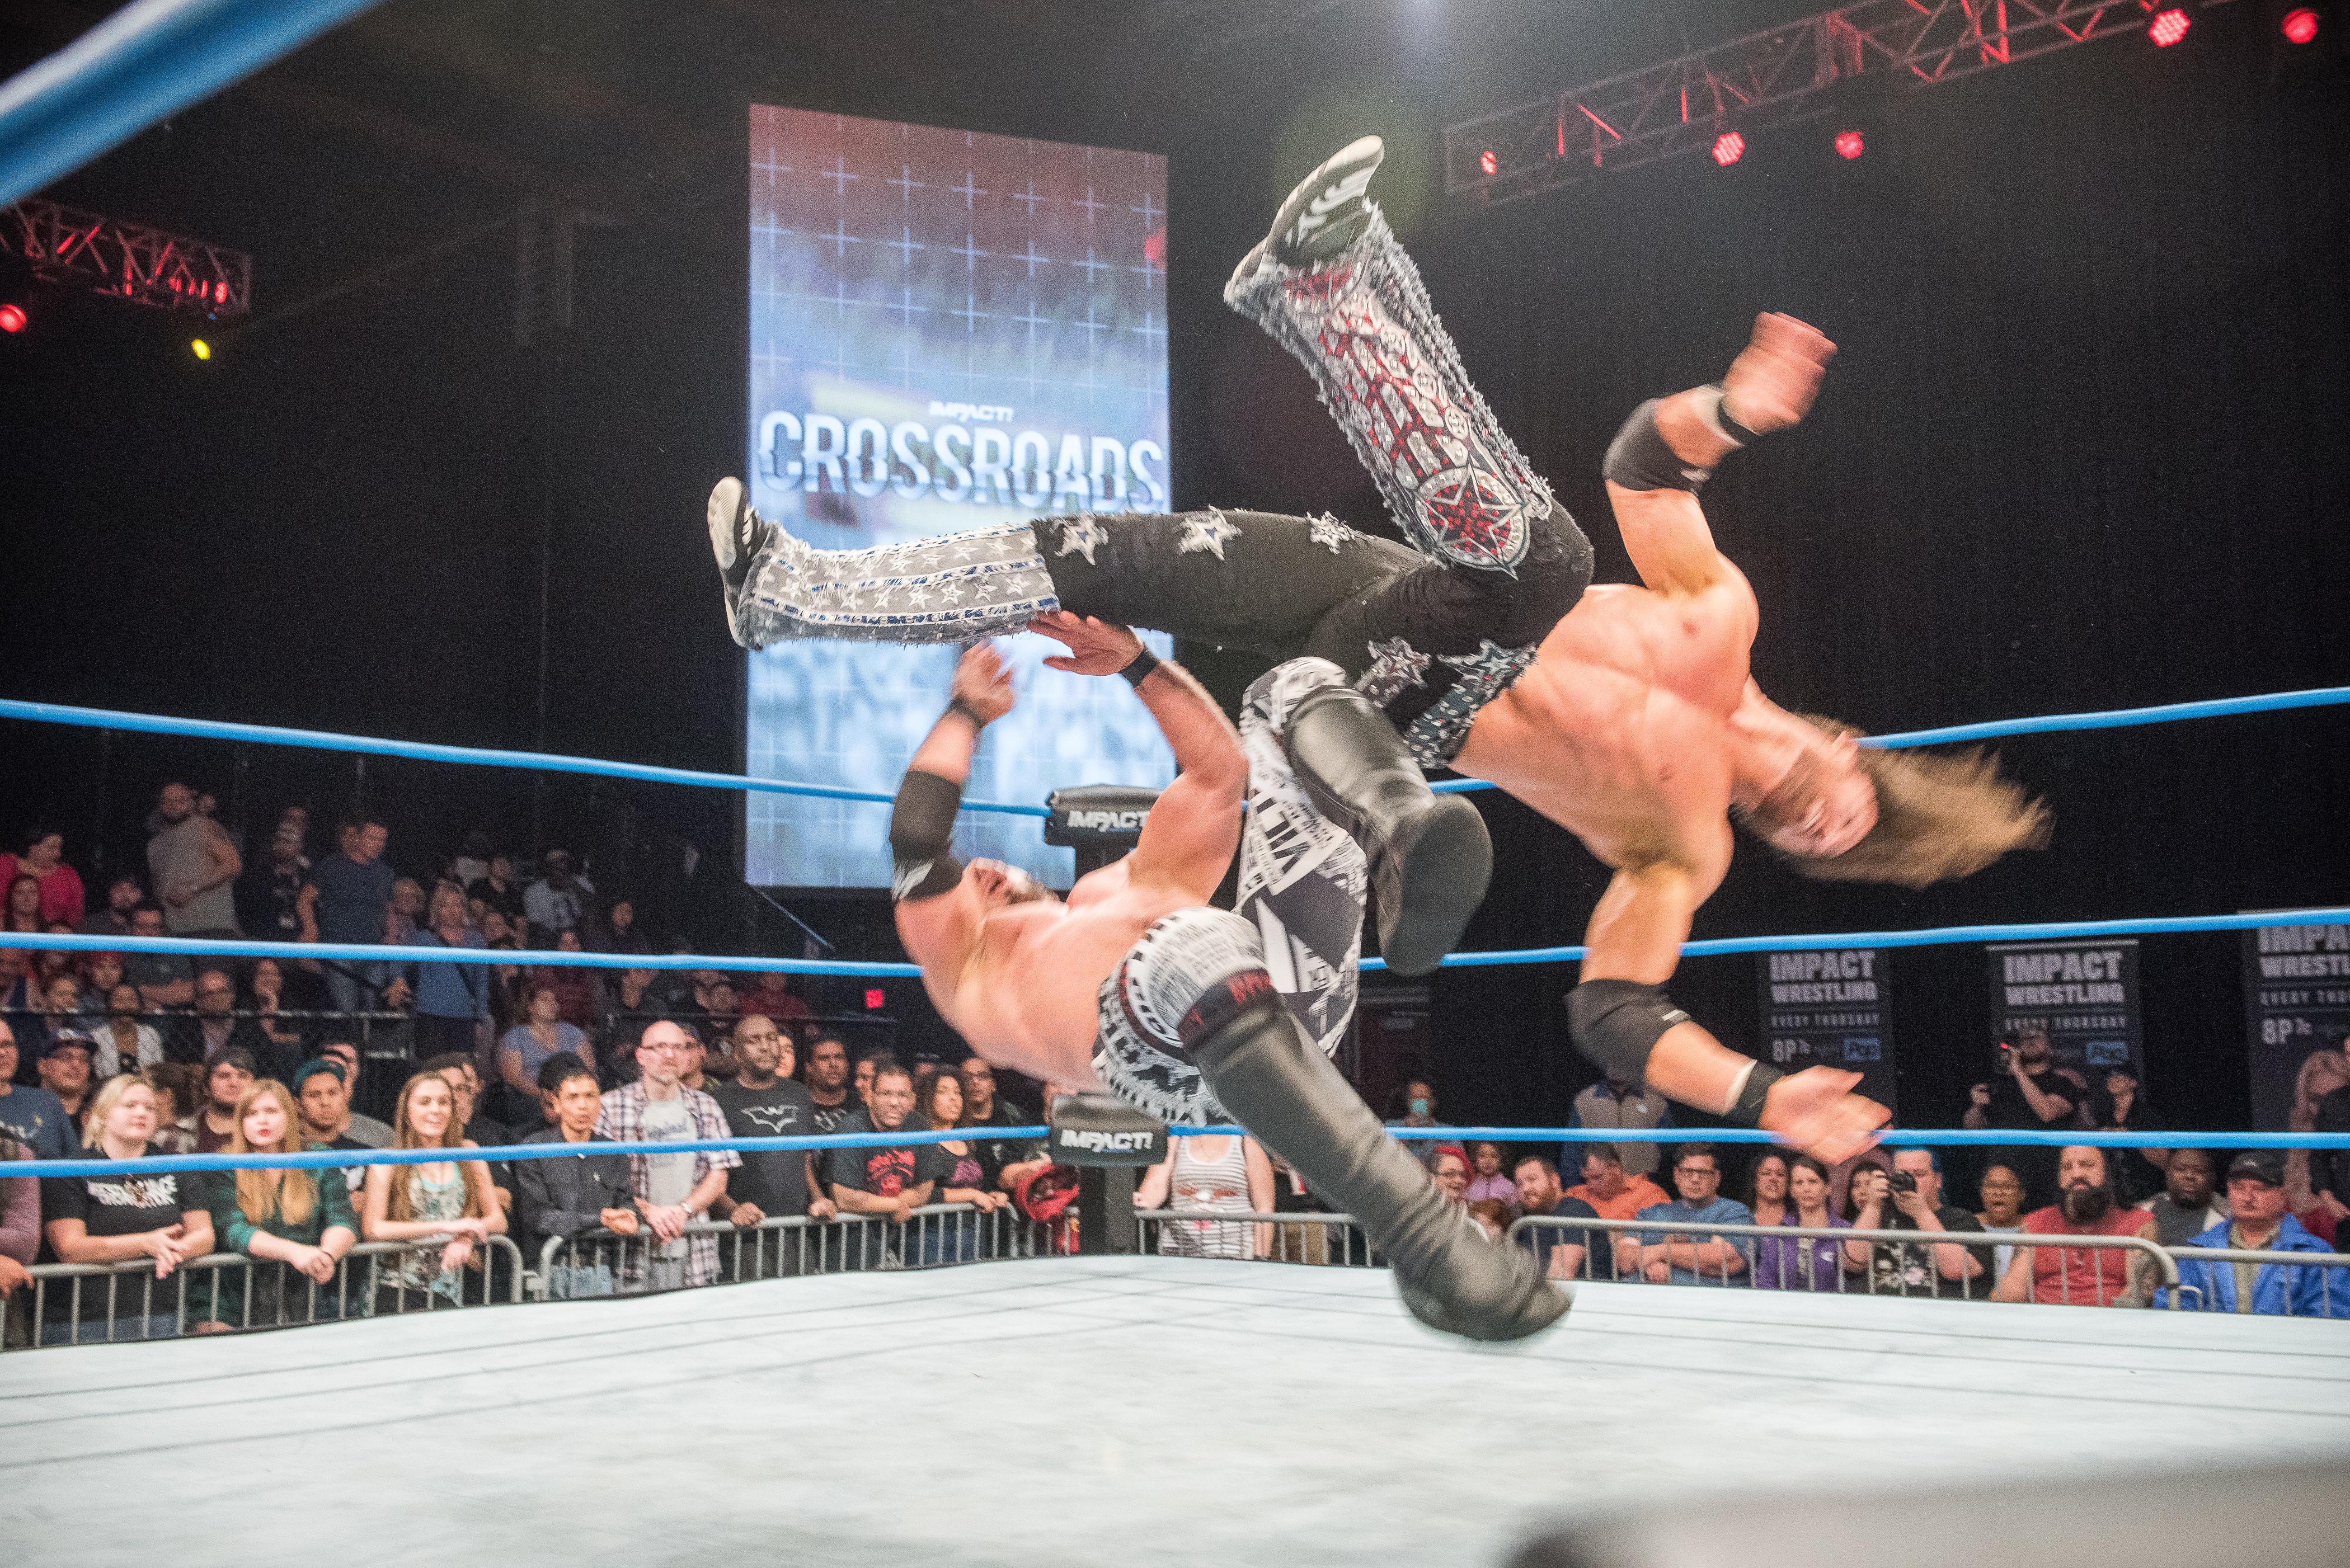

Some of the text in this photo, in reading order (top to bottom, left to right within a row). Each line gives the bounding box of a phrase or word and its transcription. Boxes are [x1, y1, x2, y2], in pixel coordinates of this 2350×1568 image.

[929, 401, 1014, 423] IMPACT!
[758, 410, 1165, 514] CROSSROADS
[1769, 950, 1875, 981] IMPACT
[2004, 950, 2123, 982] IMPACT
[1771, 981, 1878, 1004] WRESTLING
[2005, 982, 2125, 1005] WRESTLING
[1060, 1129, 1154, 1153] IMPACT!
